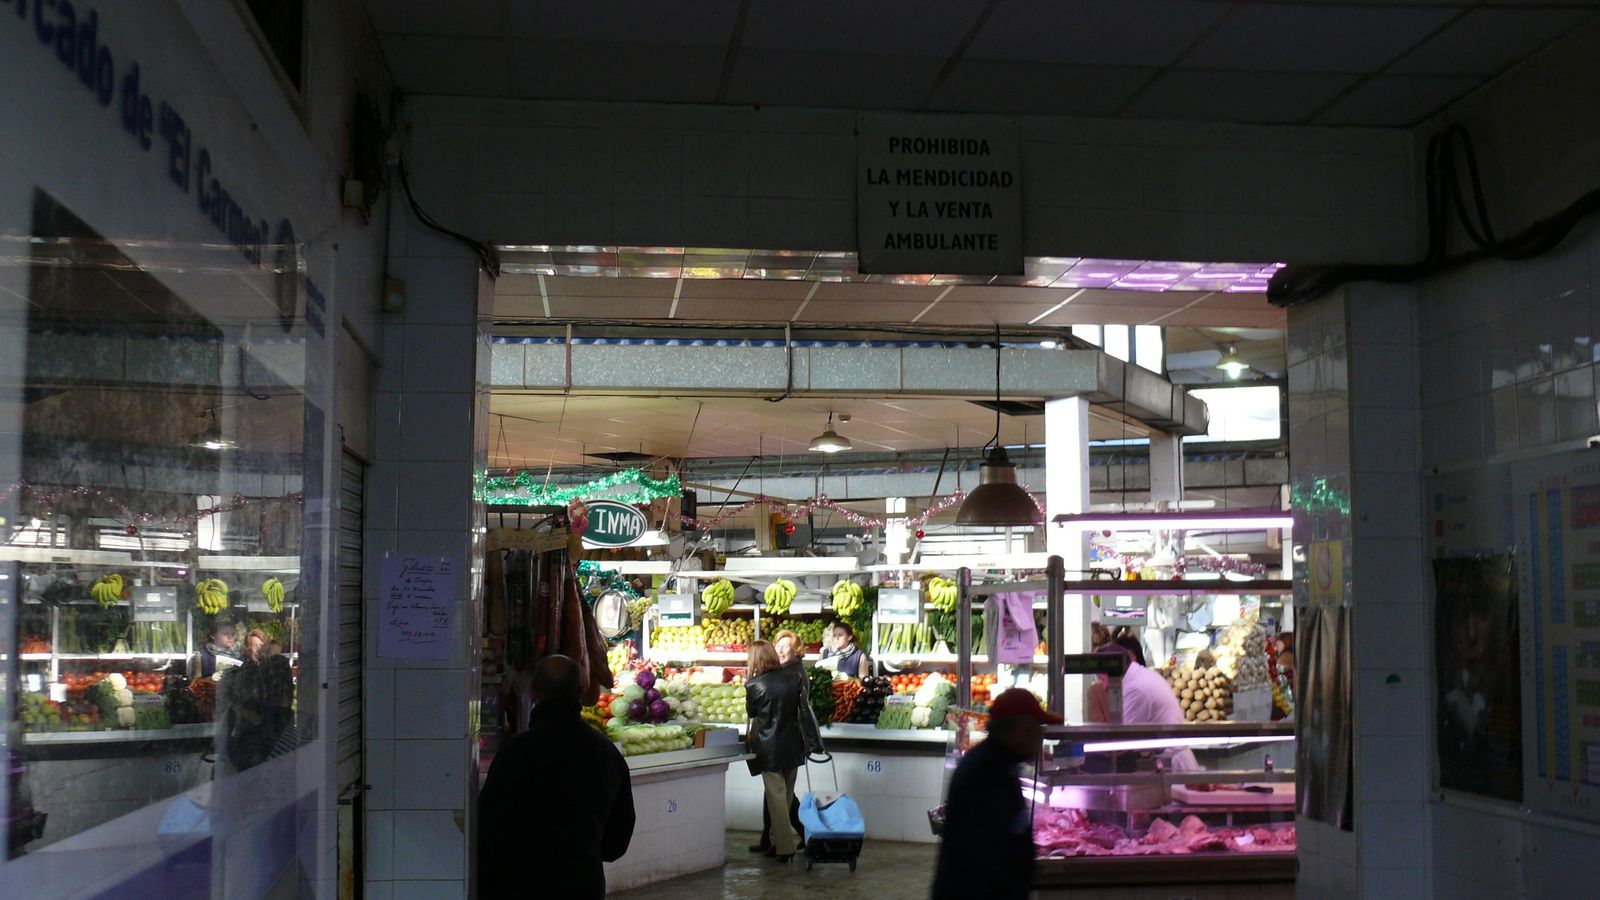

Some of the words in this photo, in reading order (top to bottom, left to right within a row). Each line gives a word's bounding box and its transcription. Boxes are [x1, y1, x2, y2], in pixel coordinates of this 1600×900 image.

[121, 62, 154, 151] de
[889, 137, 991, 156] PROHIBIDA
[867, 168, 889, 185] LA
[896, 169, 1013, 188] MENDICIDAD
[888, 201, 900, 217] Y
[906, 201, 929, 218] LA
[934, 201, 994, 219] VENTA
[884, 233, 999, 250] AMBULANTE
[594, 508, 640, 536] INMA
[867, 760, 881, 773] 68
[667, 799, 678, 813] 26
